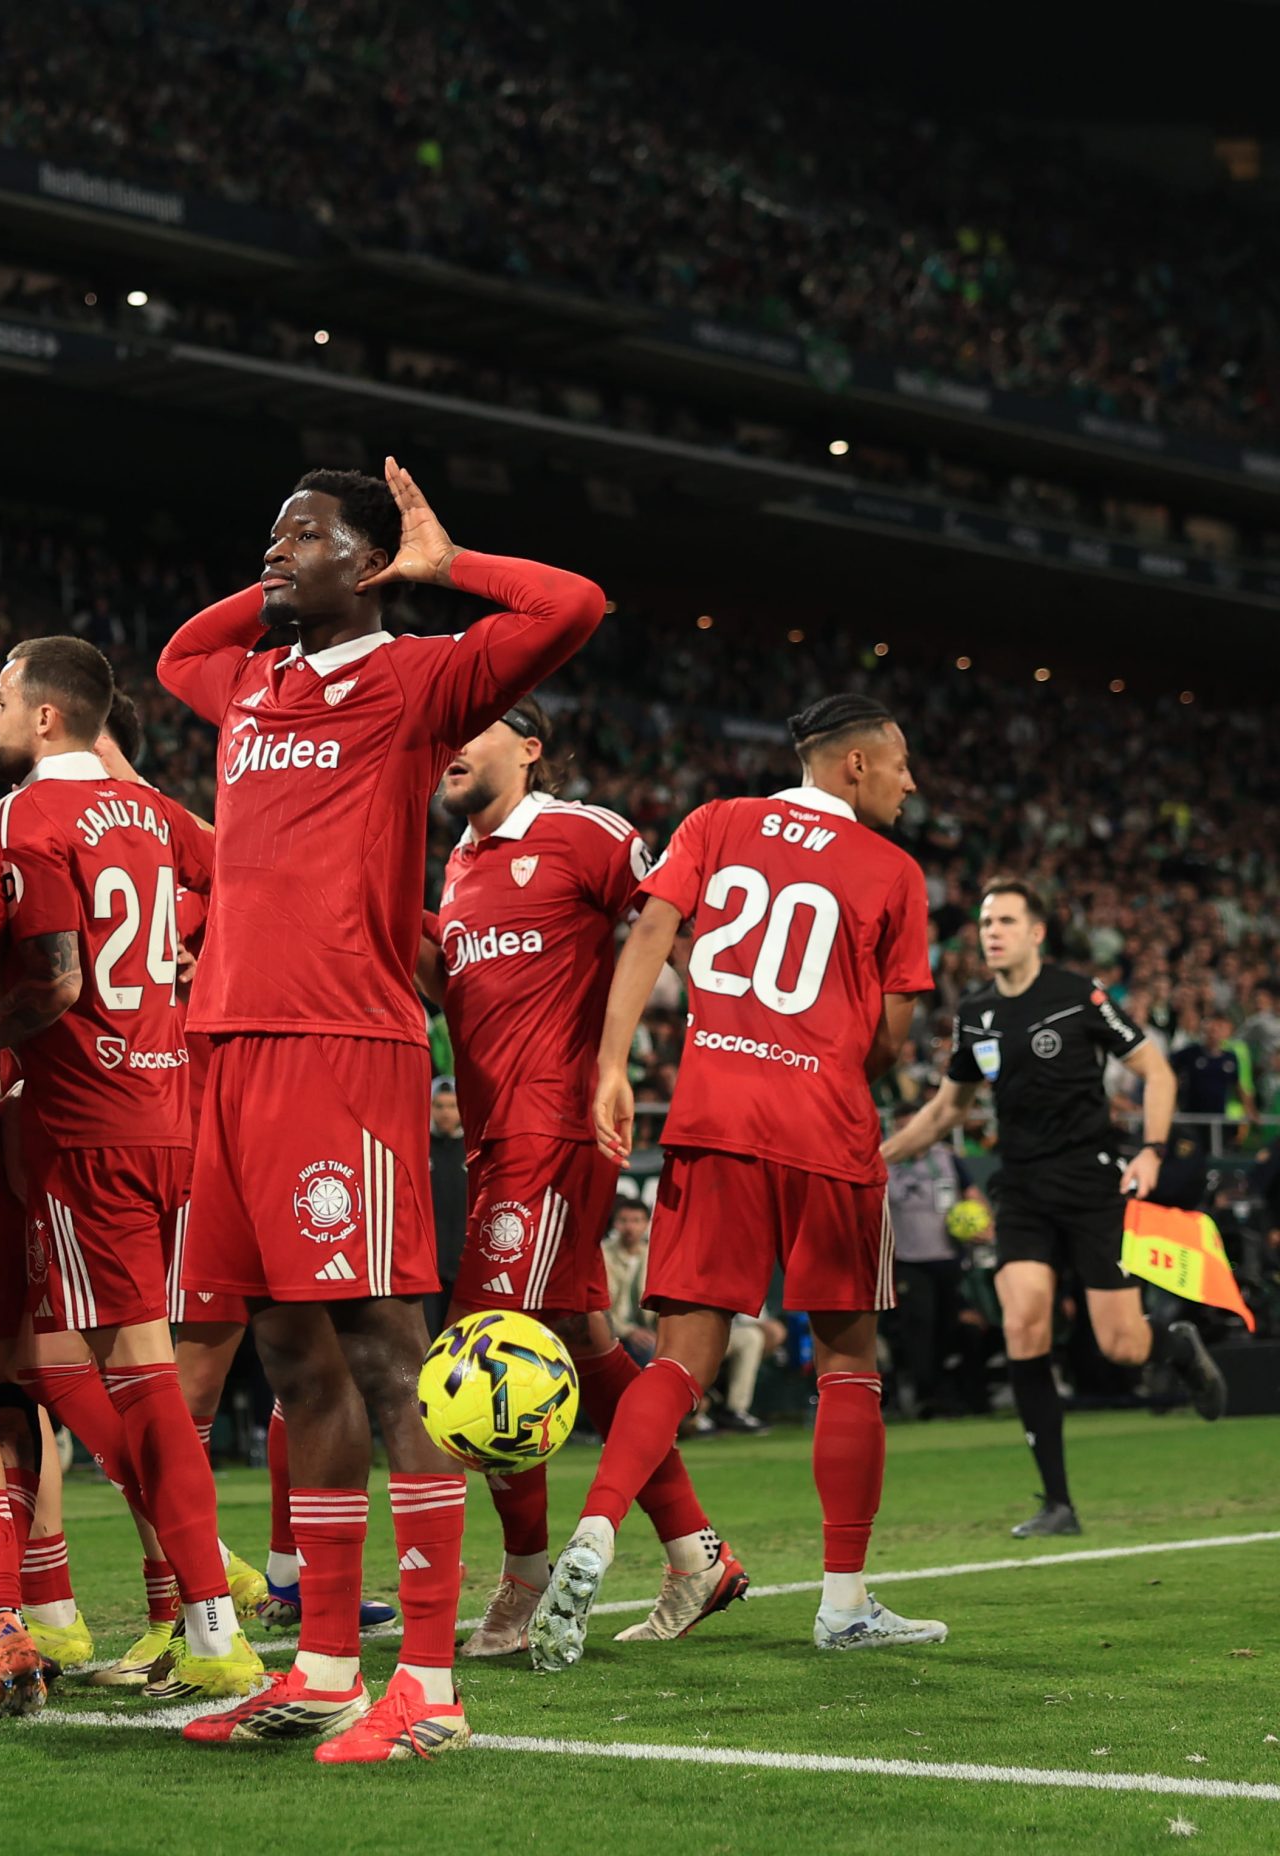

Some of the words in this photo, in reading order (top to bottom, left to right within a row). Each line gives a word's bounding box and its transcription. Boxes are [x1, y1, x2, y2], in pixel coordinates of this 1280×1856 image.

[224, 716, 340, 785] Midea
[761, 813, 837, 852] SOW
[93, 866, 177, 1010] 24
[442, 920, 543, 977] Midea
[688, 864, 840, 1016] 20
[298, 1160, 326, 1182] JUICE
[327, 1160, 355, 1179] TIME
